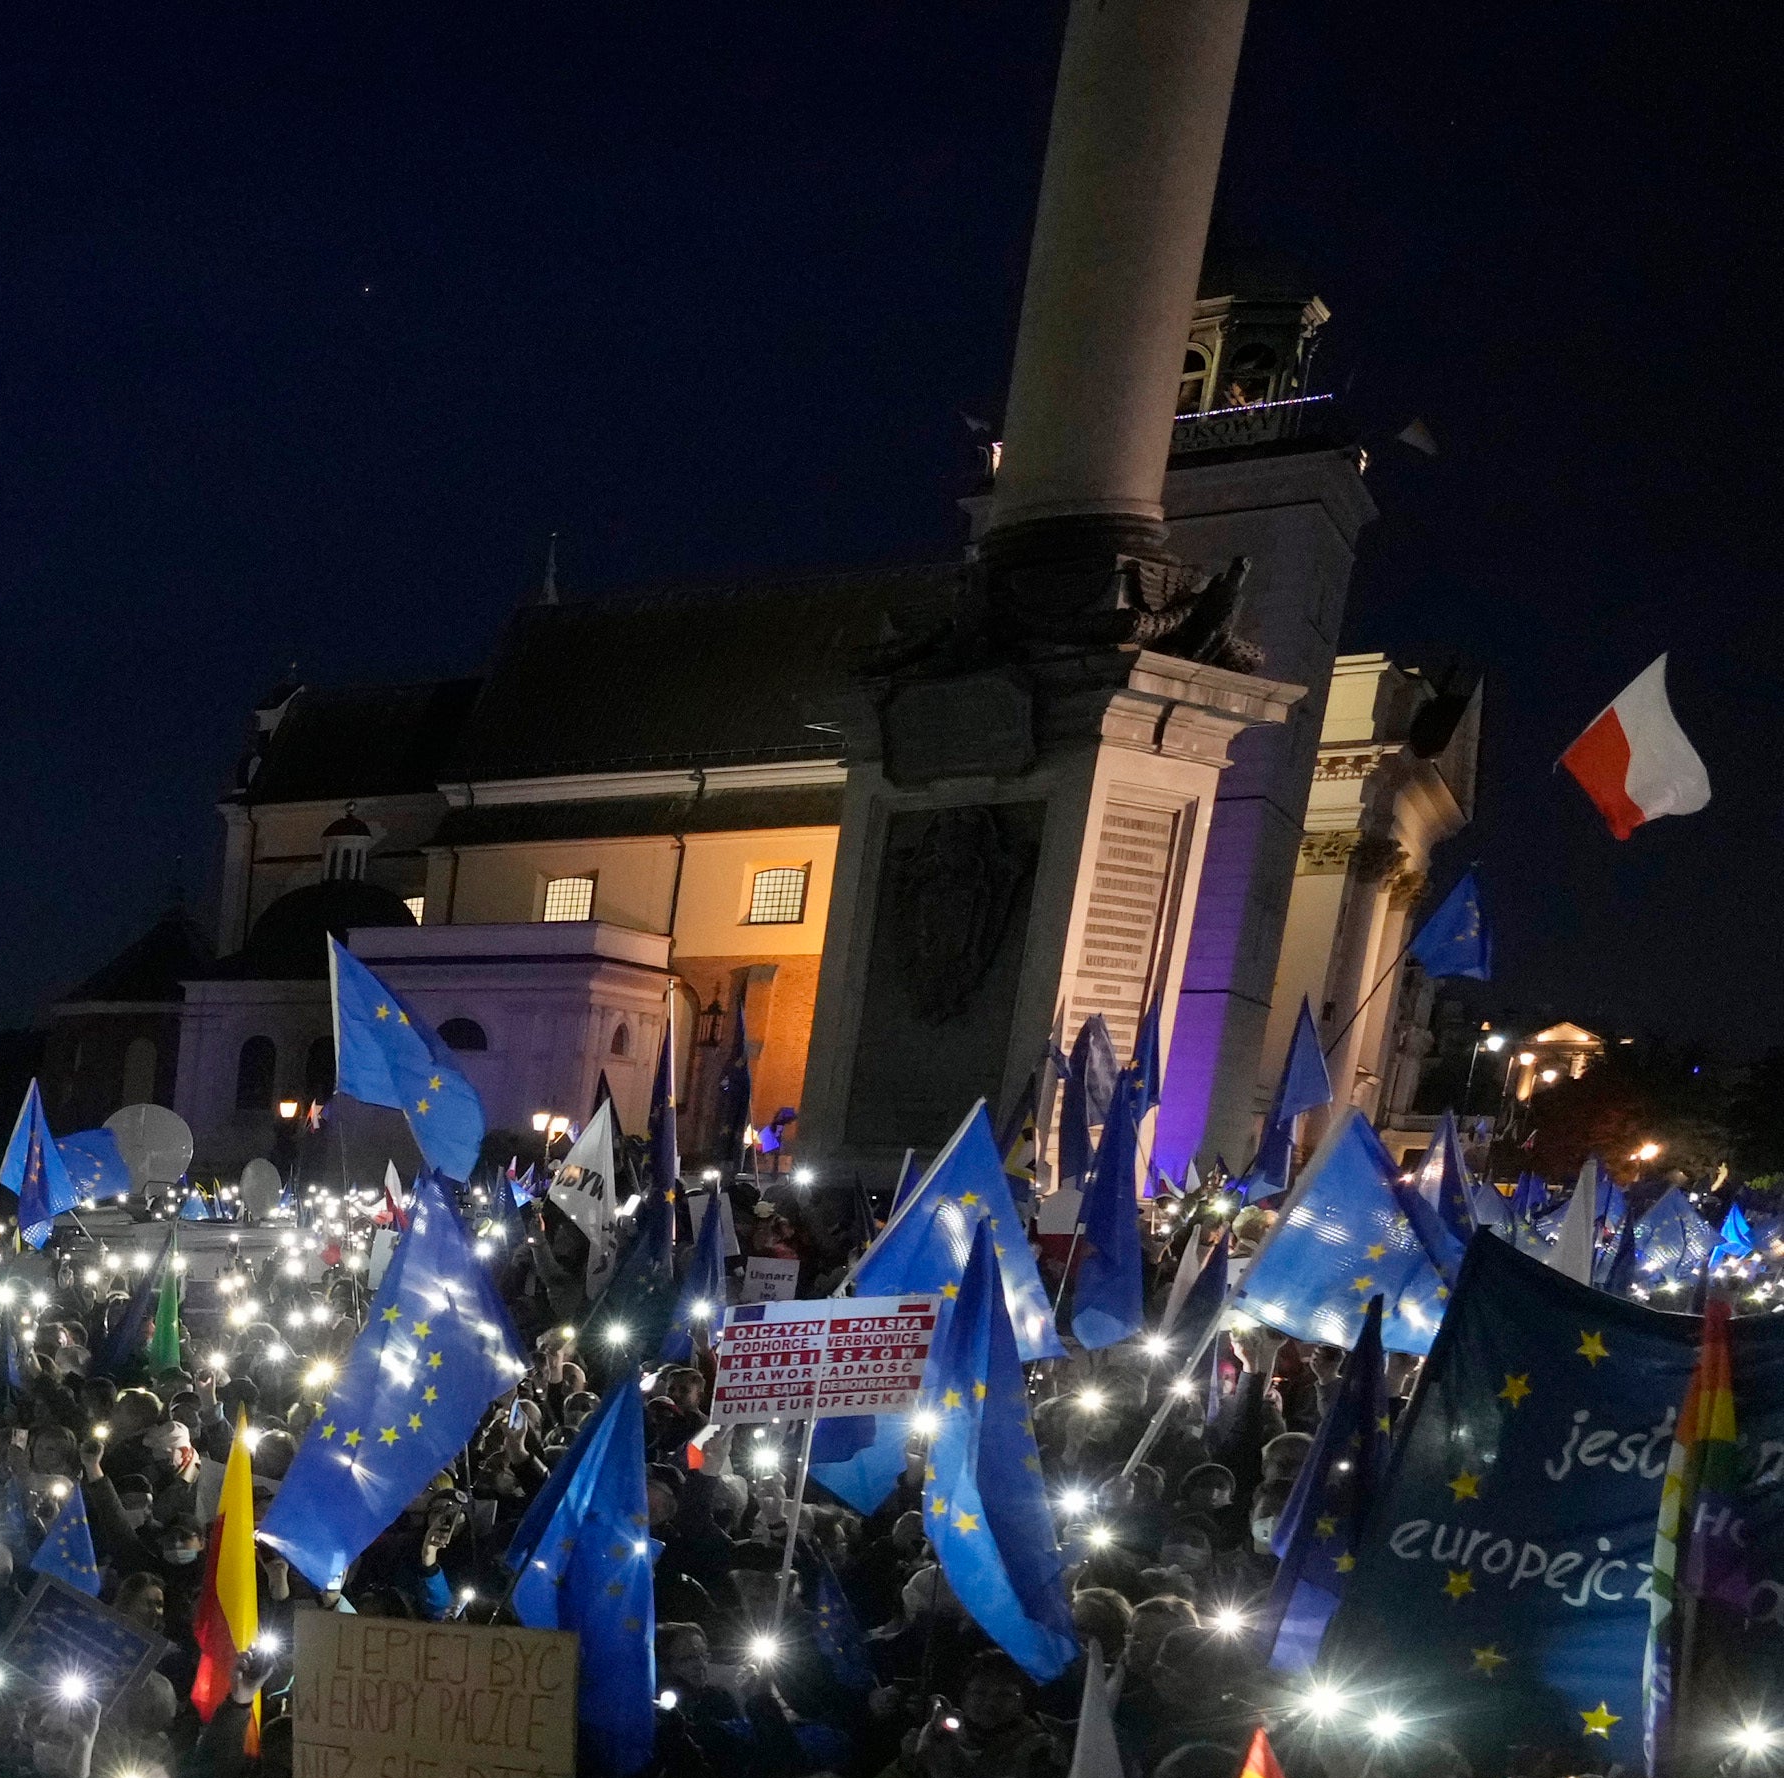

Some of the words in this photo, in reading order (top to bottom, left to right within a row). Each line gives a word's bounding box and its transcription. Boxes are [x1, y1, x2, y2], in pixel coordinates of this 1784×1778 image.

[847, 1317, 922, 1332] POLSKA
[733, 1338, 810, 1354] PODHORCE
[723, 1386, 770, 1399] WOLNE
[772, 1382, 808, 1399] SĄDY
[821, 1376, 911, 1393] DEMOKRACJA
[723, 1398, 769, 1414] UNIA
[776, 1392, 908, 1412] EUROPEJSKA
[1544, 1405, 1678, 1482] jest
[336, 1623, 471, 1686] LEPIEJ
[330, 1675, 424, 1738] EUROPY
[439, 1687, 554, 1753] PACZCE
